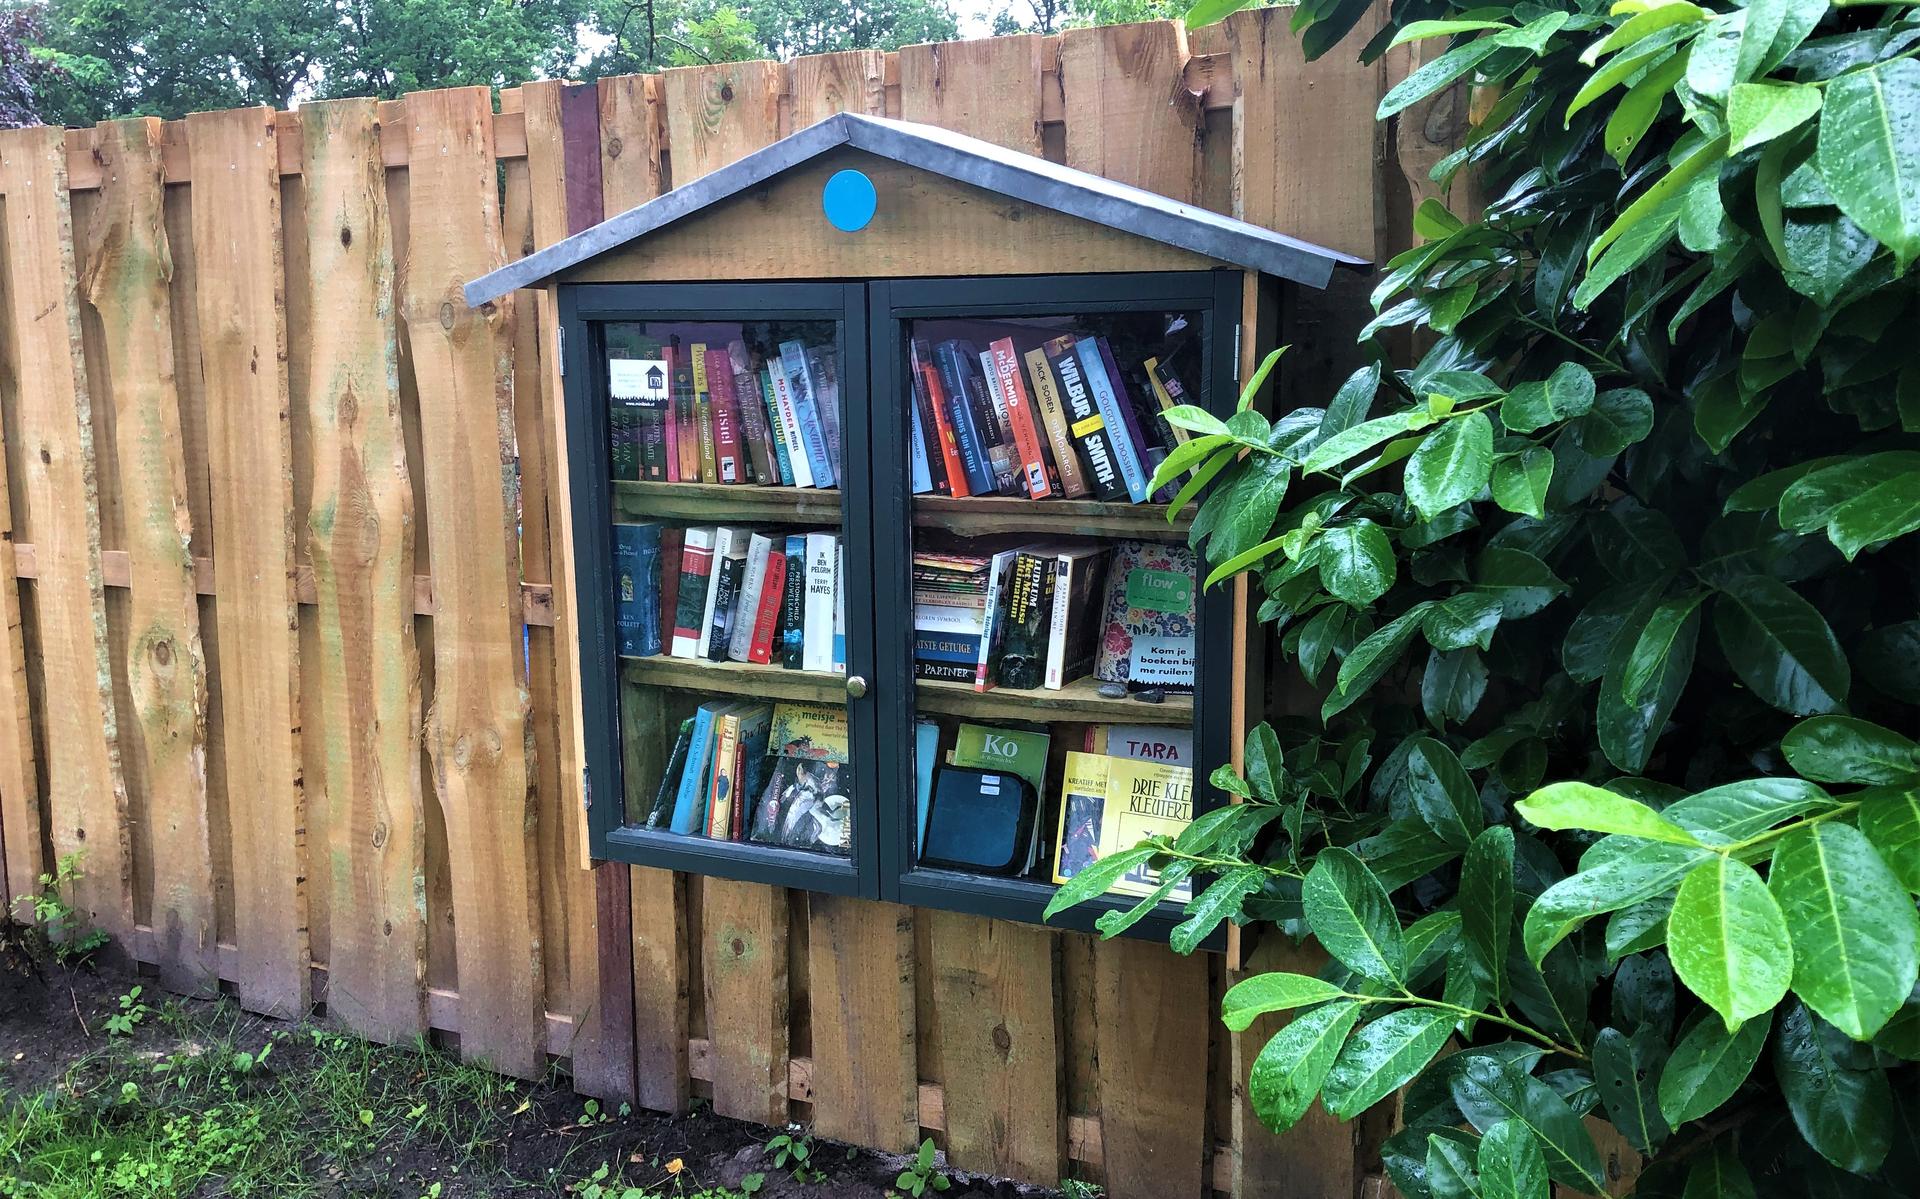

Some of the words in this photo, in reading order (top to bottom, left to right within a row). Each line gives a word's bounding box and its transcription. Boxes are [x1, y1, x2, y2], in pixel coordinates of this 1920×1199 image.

[1006, 356, 1017, 374] VAL
[777, 378, 786, 392] MO
[995, 349, 1018, 407] McDERMID
[1033, 360, 1047, 382] JACK
[1040, 384, 1055, 413] SOREN
[1058, 355, 1091, 419] WILBUR
[764, 383, 778, 412] PANIC
[771, 415, 785, 445] ROOM
[780, 393, 794, 428] HAYDER
[951, 404, 967, 433] TORENS
[998, 402, 1011, 427] LION
[701, 406, 712, 460] Niemandsland
[718, 409, 733, 444] asiel
[984, 410, 994, 439] TESTAMENT
[959, 433, 970, 449] VAN
[964, 449, 977, 473] STILTE
[1085, 434, 1115, 484] SMITH
[816, 558, 827, 566] BEN
[819, 551, 826, 559] IK
[810, 566, 831, 574] PELGRIM
[1025, 557, 1035, 577] Het
[810, 584, 831, 595] HAYES
[1010, 556, 1025, 618] ultimatum
[1029, 559, 1043, 607] LUDLUM
[1142, 572, 1173, 590] flow
[786, 571, 795, 627] GRUWELKAMER
[1018, 577, 1033, 625] Medusa
[939, 641, 972, 654] GETUIGE
[1151, 646, 1175, 655] Kom
[1177, 647, 1187, 657] je
[924, 663, 969, 678] PARTNER
[1140, 655, 1180, 665] boeken
[1182, 657, 1195, 667] bij
[1158, 667, 1193, 676] ruilen?
[801, 710, 835, 724] meisje
[982, 733, 1019, 757] Ko
[1126, 740, 1179, 760] TARA
[1068, 777, 1094, 785] KREATIEF
[1132, 777, 1162, 797] DRIE
